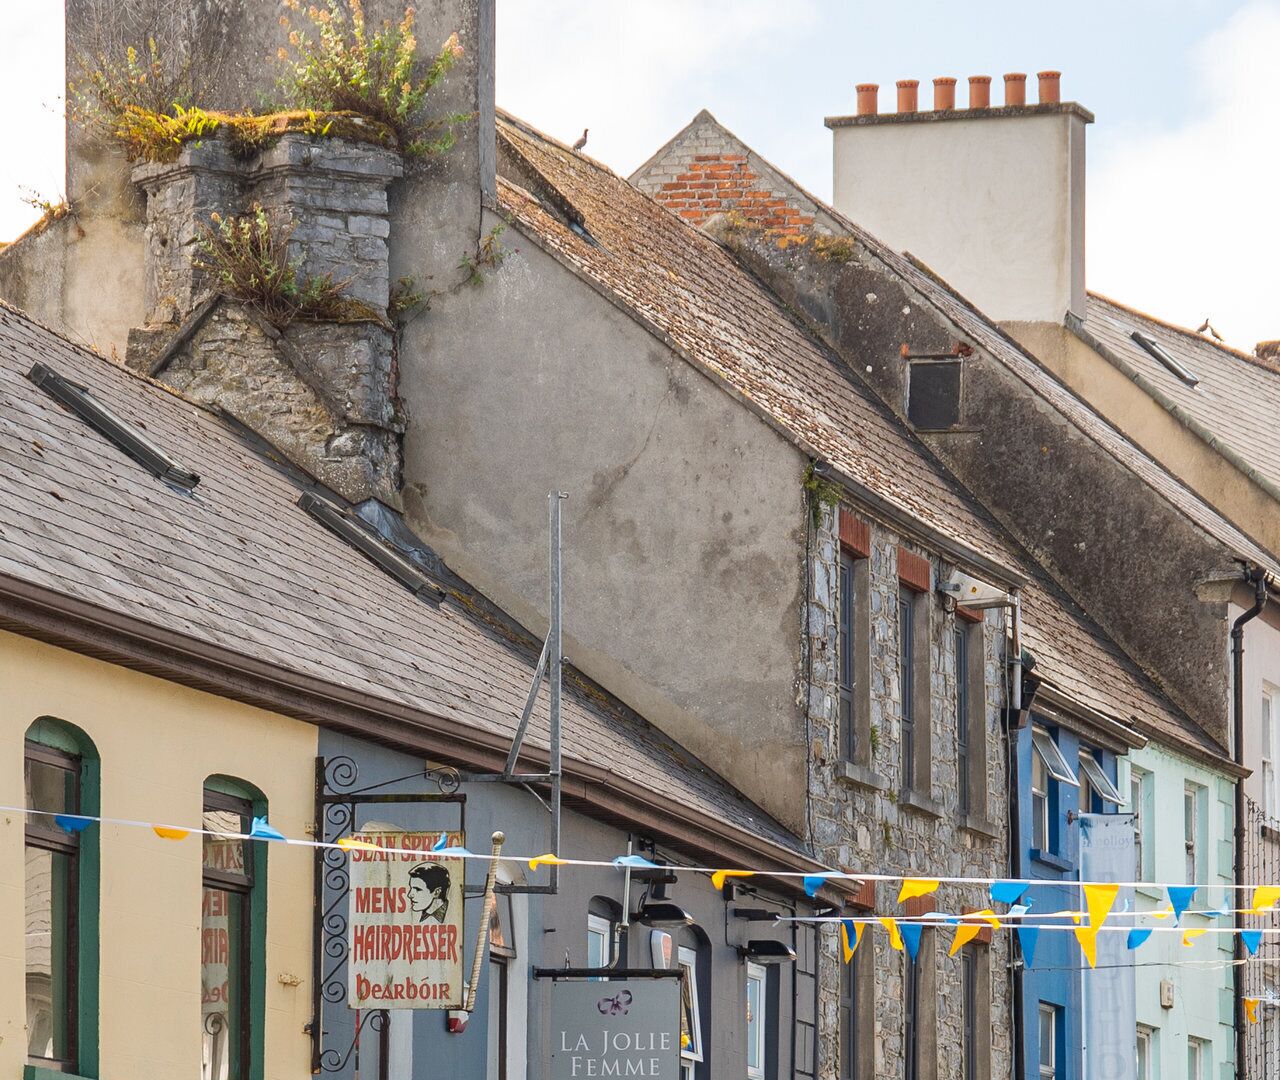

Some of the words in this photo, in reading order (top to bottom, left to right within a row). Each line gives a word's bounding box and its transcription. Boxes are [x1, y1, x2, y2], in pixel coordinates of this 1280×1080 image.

[401, 833, 461, 862] SPRIG
[356, 887, 407, 914] MENS
[353, 924, 458, 965] HAIRDRESSER
[561, 1031, 590, 1052] LA
[601, 1030, 671, 1056] JOLIE
[571, 1056, 660, 1076] FEMME
